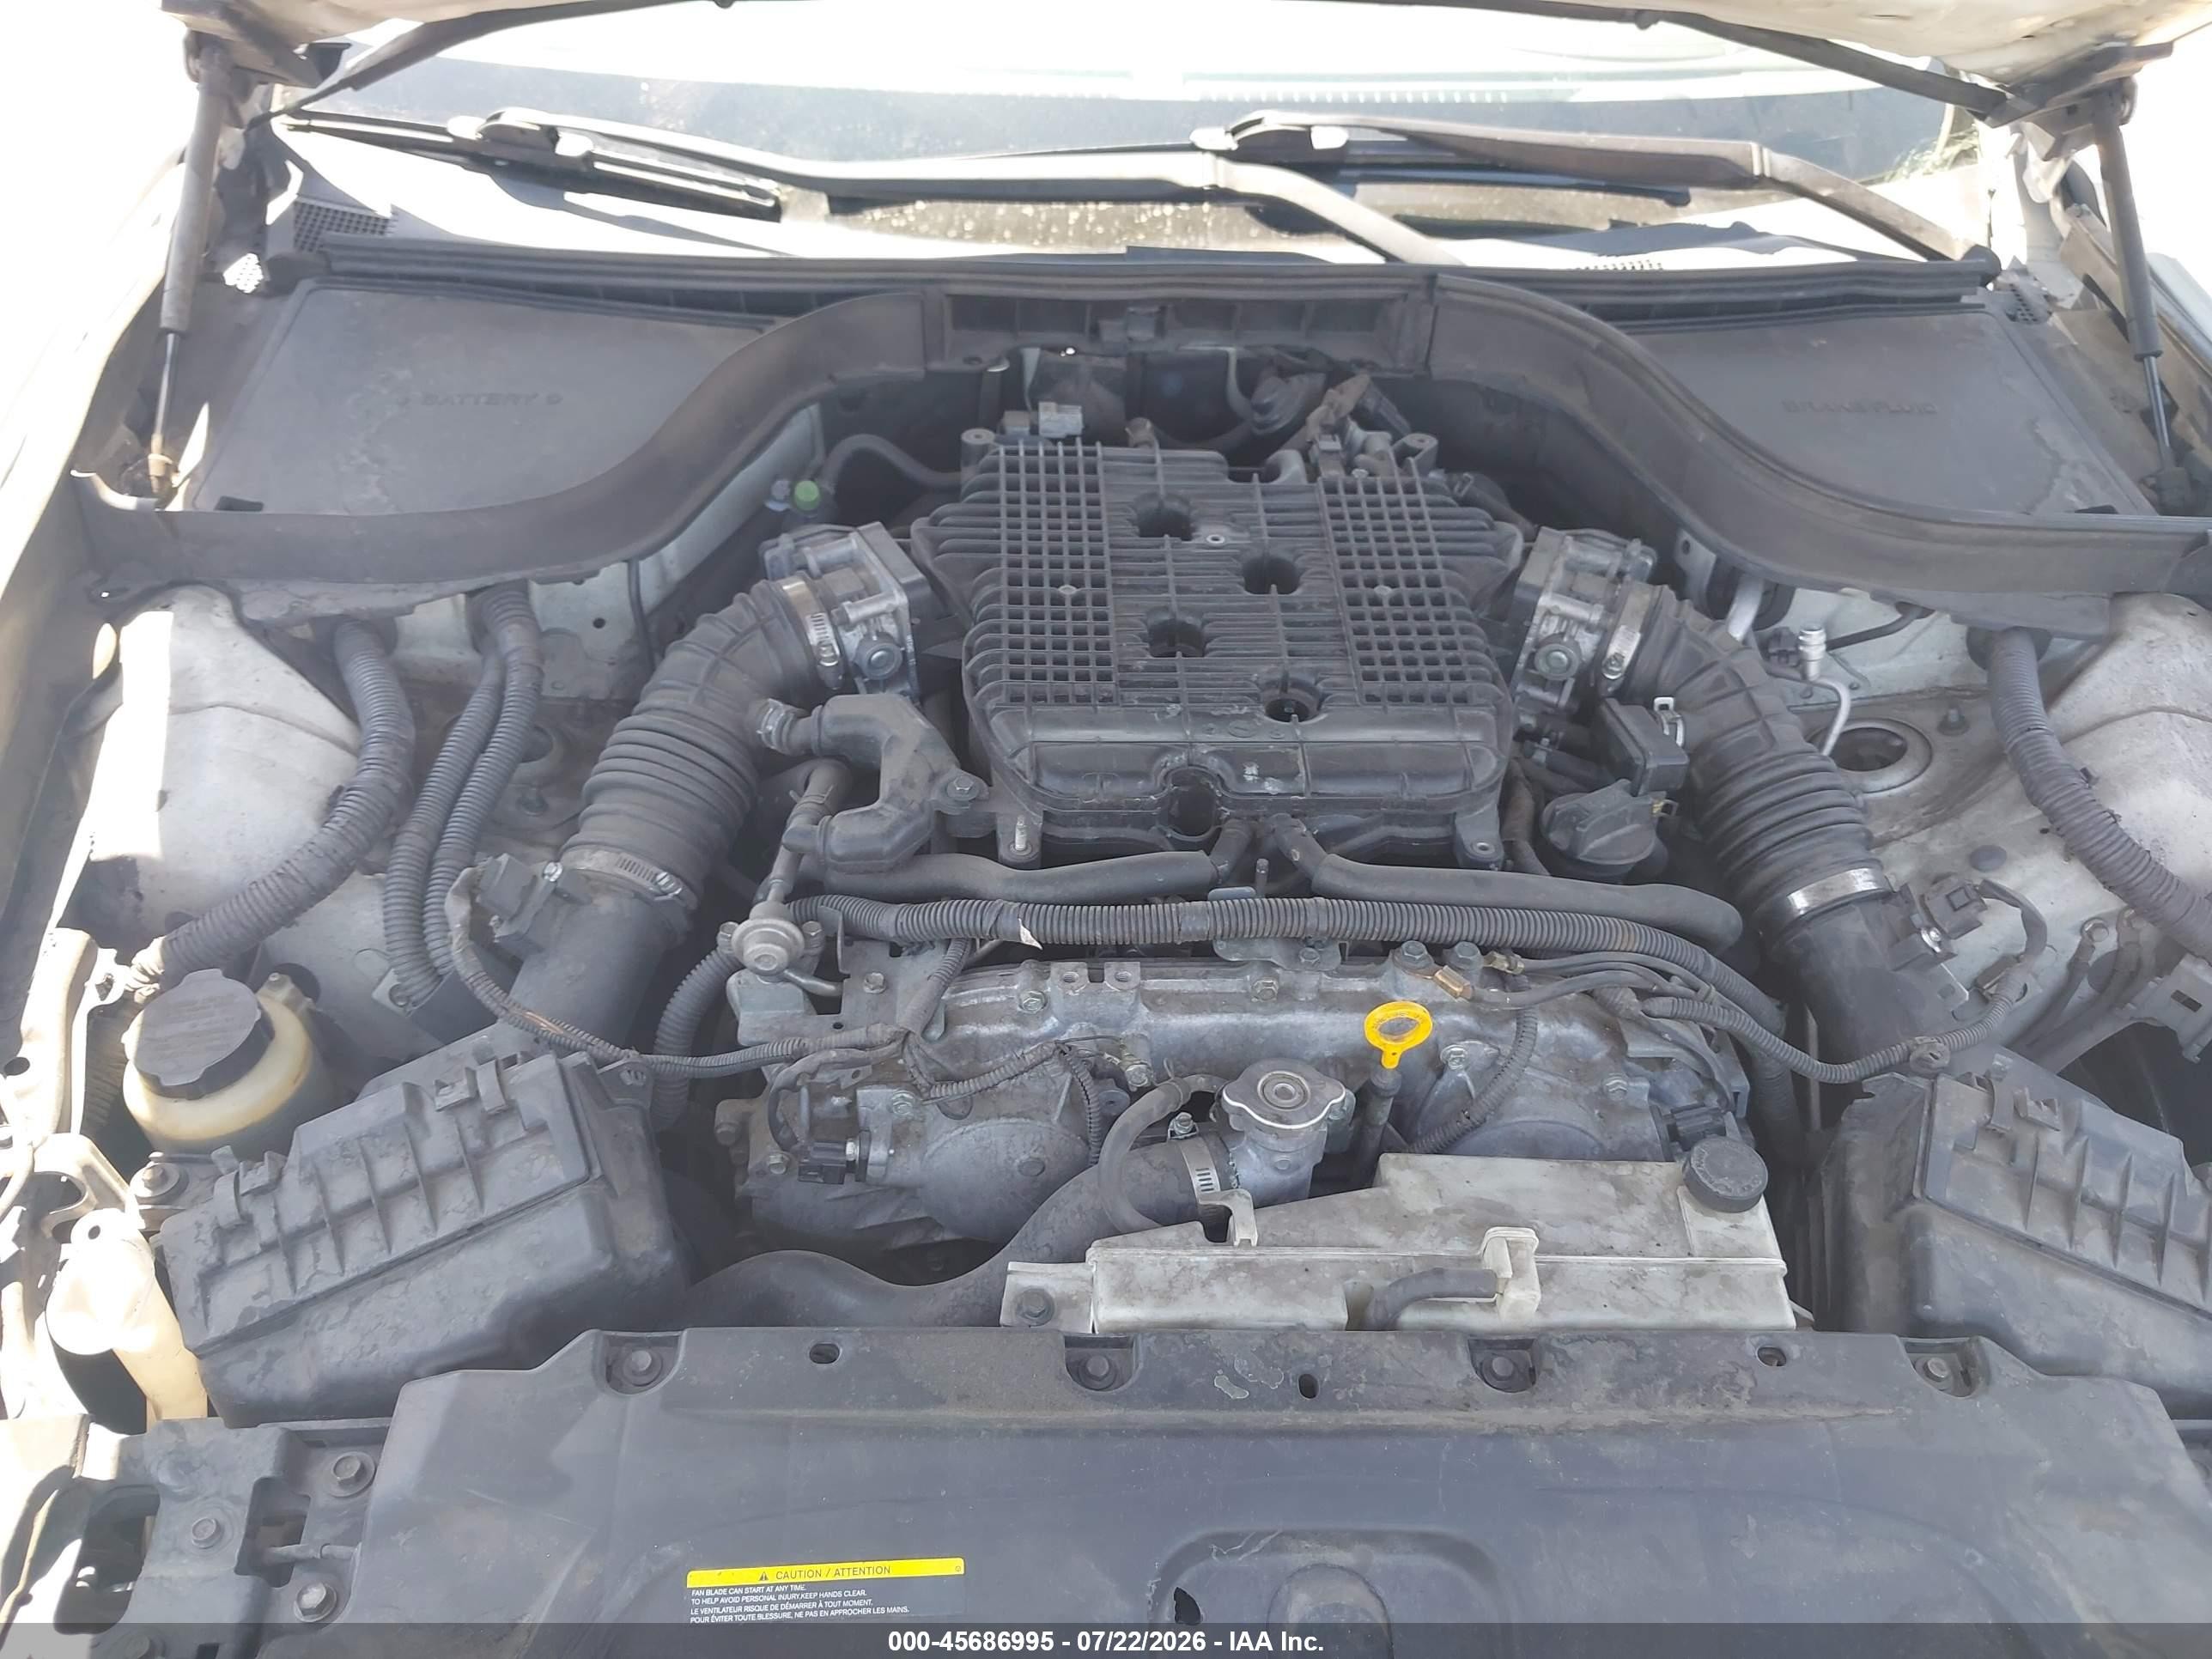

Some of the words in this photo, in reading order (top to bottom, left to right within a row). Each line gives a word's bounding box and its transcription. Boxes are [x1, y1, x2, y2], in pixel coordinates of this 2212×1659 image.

[775, 1569, 822, 1579] CAUTION
[834, 1565, 890, 1577] ATTENTION
[700, 1606, 743, 1615] VENTILATEUR
[780, 1601, 817, 1610] DÉMARRER
[710, 1613, 733, 1622] ÉVITER
[830, 1607, 872, 1616] APPROCHER
